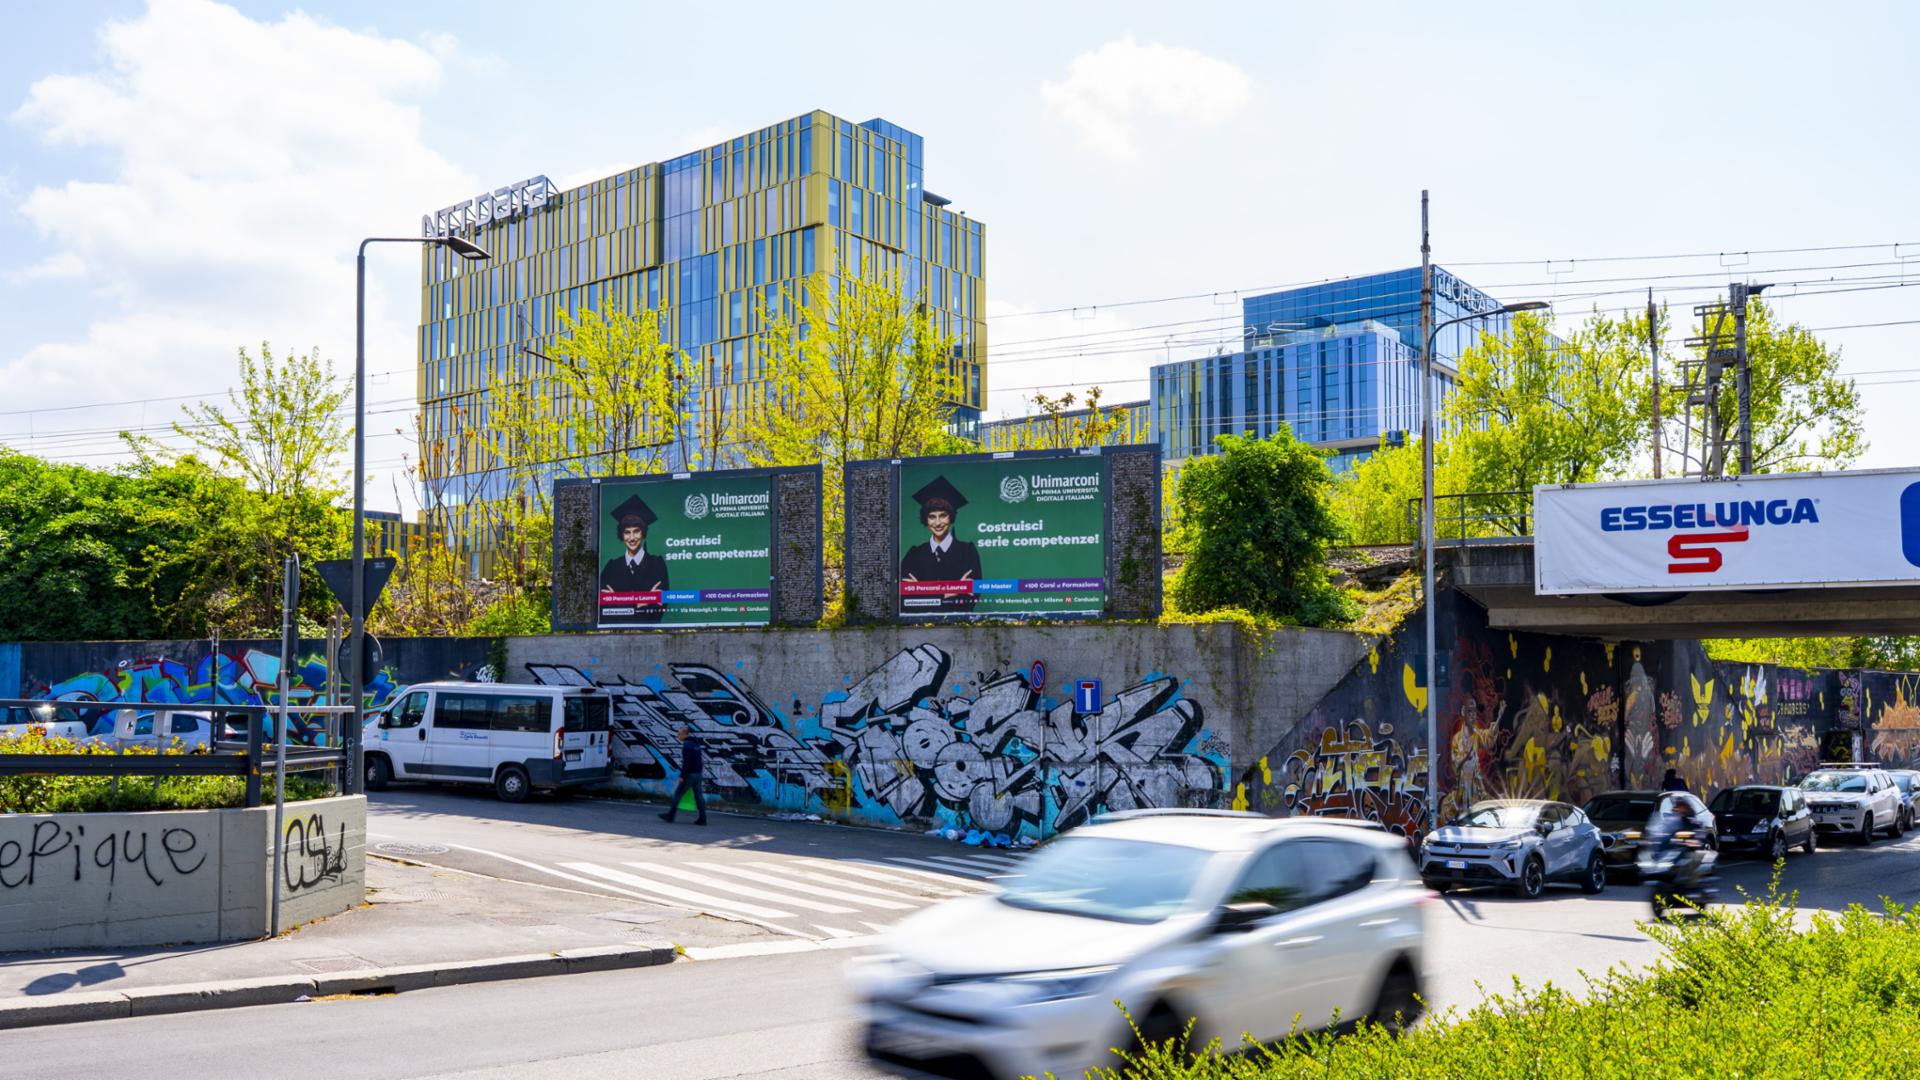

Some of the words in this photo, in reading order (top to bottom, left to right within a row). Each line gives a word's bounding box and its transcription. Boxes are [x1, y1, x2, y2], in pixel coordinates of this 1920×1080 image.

[1031, 472, 1099, 488] Unimarconi
[711, 490, 769, 506] Unimarconi
[1601, 498, 1819, 531] ESSELUNGA
[977, 519, 1043, 533] Costruisci
[665, 534, 721, 547] Costruisci
[977, 535, 1009, 548] serie
[1013, 534, 1099, 548] competenze!
[665, 549, 693, 561] serie
[695, 547, 769, 560] competenze!
